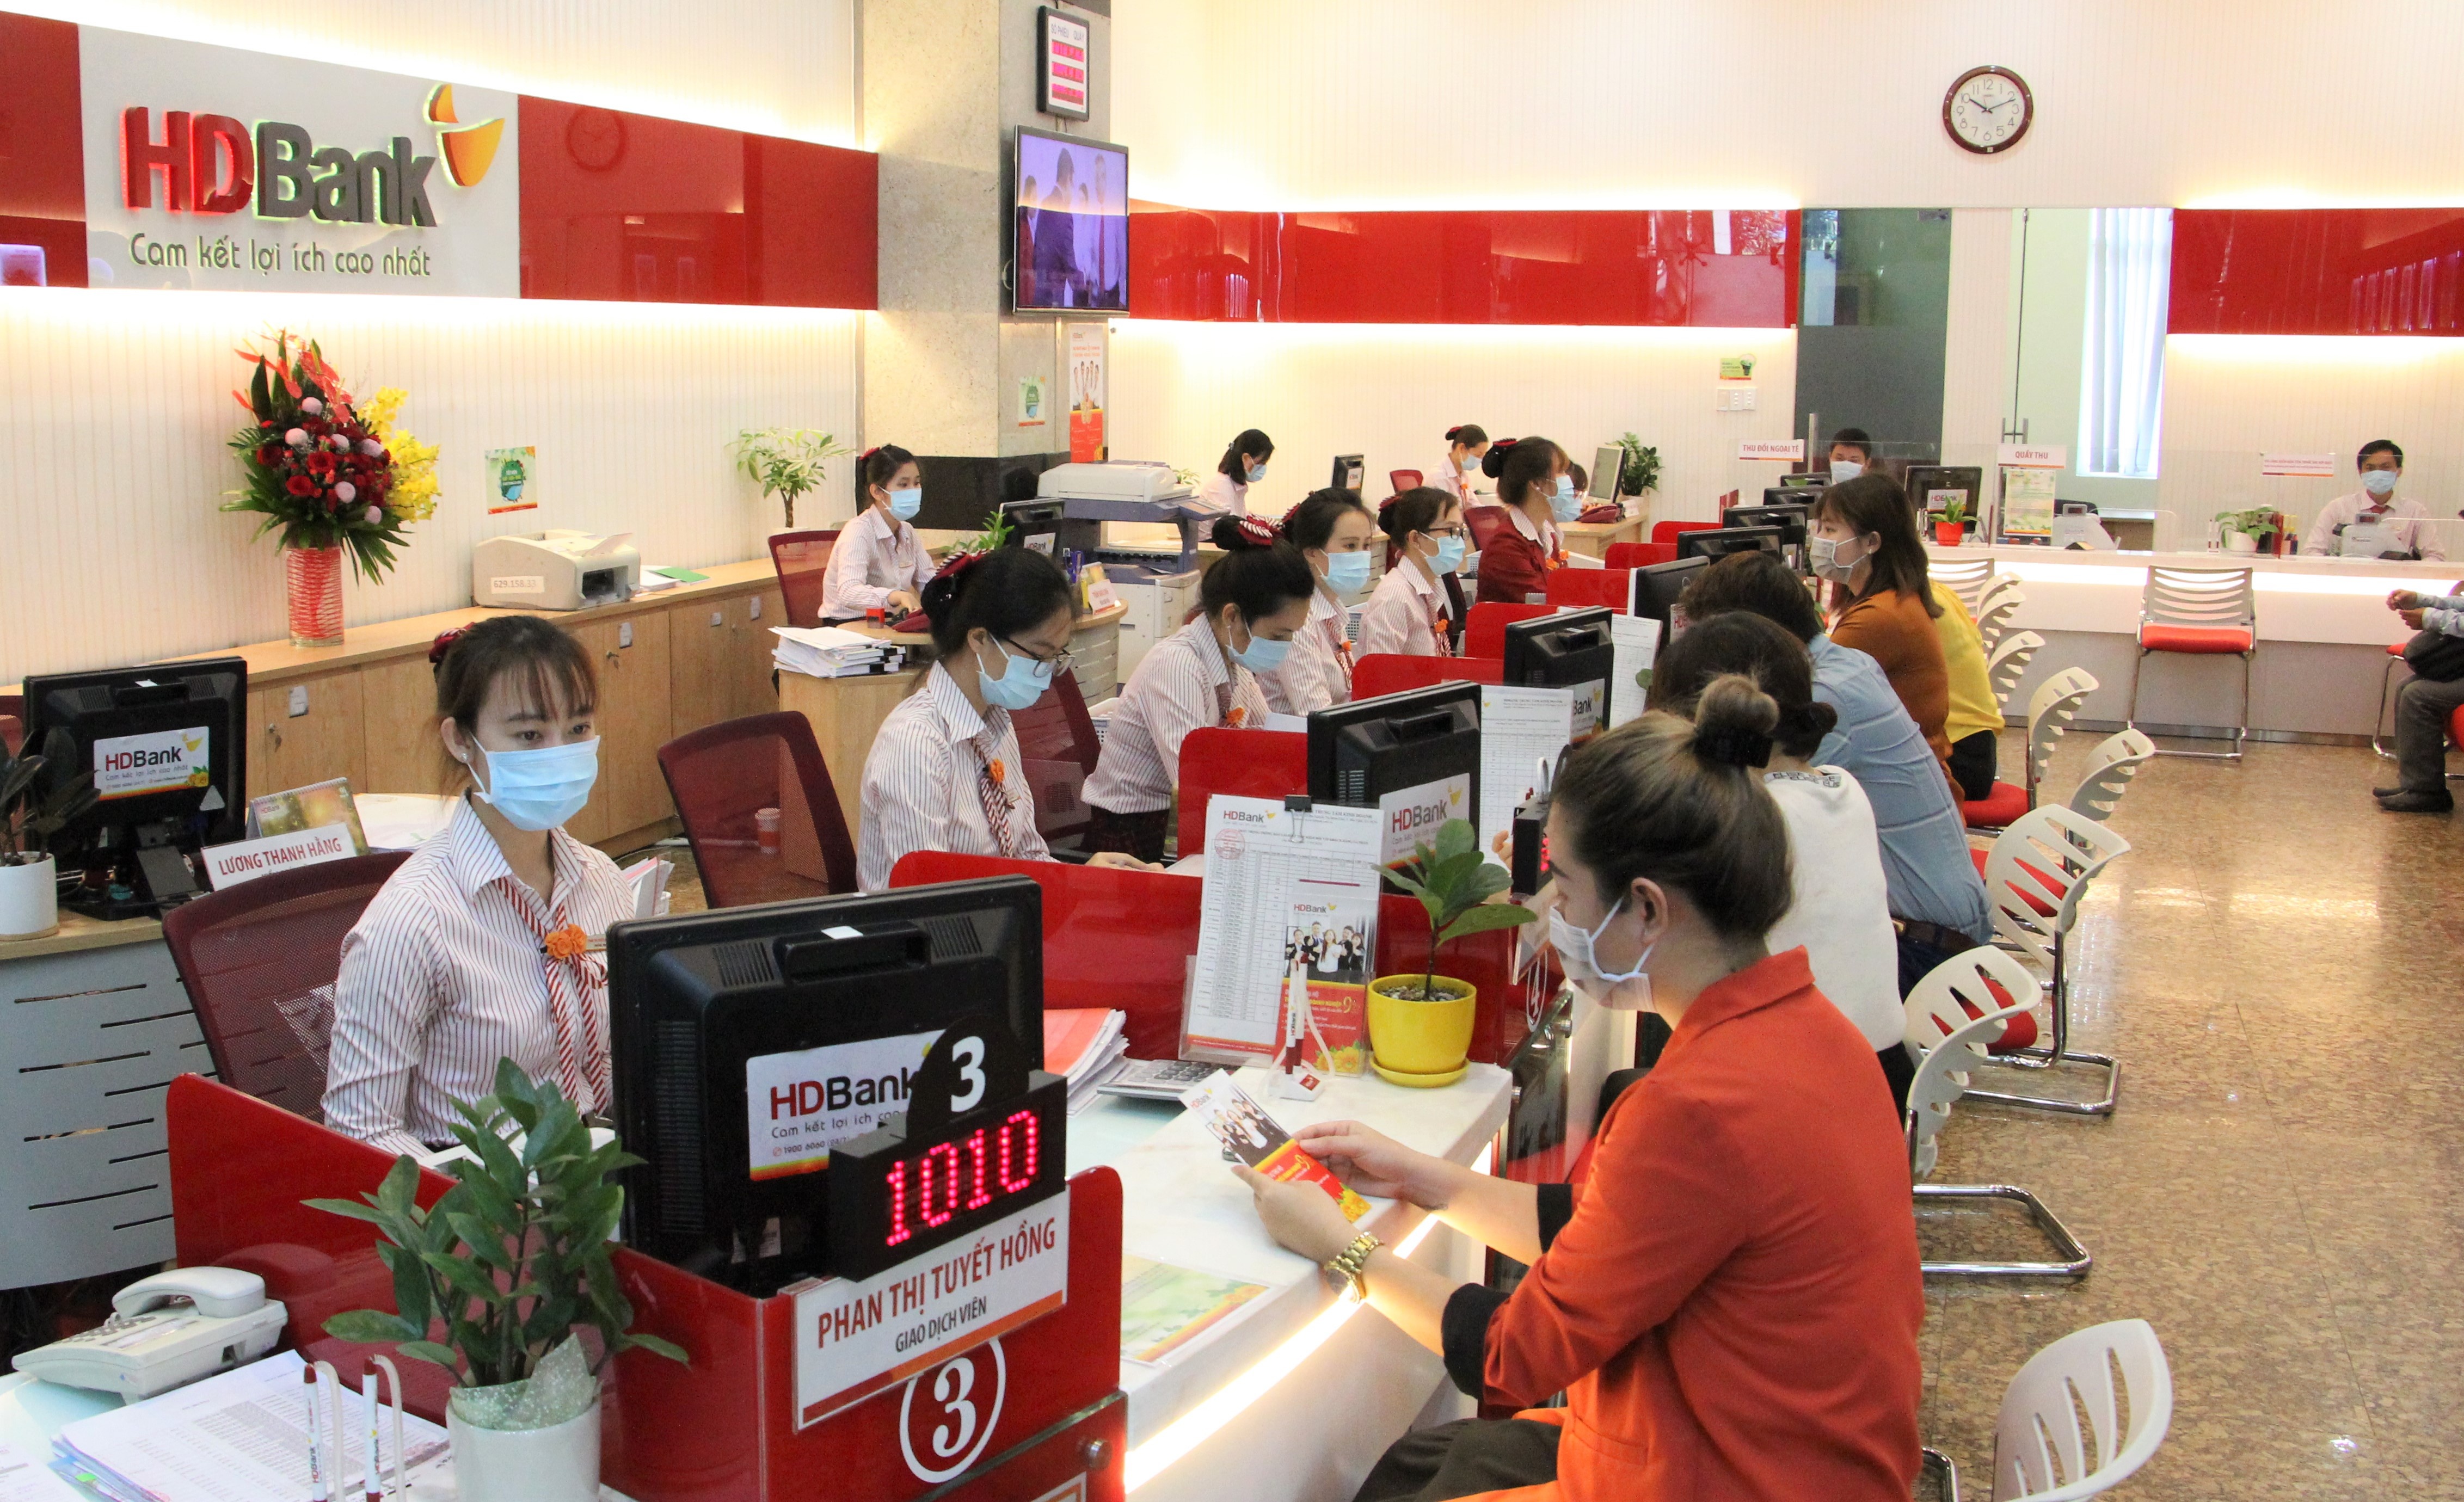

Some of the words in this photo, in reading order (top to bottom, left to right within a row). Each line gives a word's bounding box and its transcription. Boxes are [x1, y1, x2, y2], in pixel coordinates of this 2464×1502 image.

[1973, 84, 1979, 94] 11
[1983, 78, 1993, 90] 12
[1961, 93, 1970, 103] 10
[2007, 91, 2015, 102] 2
[1956, 106, 1964, 116] 9
[2012, 104, 2019, 114] 3
[1960, 119, 1967, 129] 8
[2007, 118, 2014, 126] 4
[1971, 126, 1978, 137] 7
[1983, 131, 1992, 141] 6
[1996, 126, 2004, 136] 5
[120, 106, 437, 227] HDBank
[129, 232, 187, 267] Cam
[197, 235, 241, 269] kết
[249, 237, 281, 276] lợi
[293, 242, 325, 273] ích
[334, 251, 374, 275] cao
[382, 244, 432, 277] nhất
[1771, 445, 1790, 454] NGOẠI
[106, 746, 181, 772] HDBank
[1224, 810, 1264, 823] HDBank
[1393, 799, 1447, 833] HDBank
[218, 852, 262, 876] LƯƠNG
[262, 845, 306, 866] THANH
[307, 836, 342, 858] HẰNG
[1294, 903, 1327, 913] HDBank
[950, 1036, 986, 1112] 3
[771, 1067, 919, 1120] HDBank
[772, 1126, 798, 1138] Cam
[805, 1120, 826, 1132] kết
[832, 1118, 848, 1129] lợi
[853, 1112, 872, 1125] ích
[784, 1144, 802, 1154] 1900
[886, 1110, 1038, 1247] 1010
[818, 1289, 882, 1349] PHAN
[889, 1273, 925, 1315] THỊ
[931, 1236, 996, 1300] TUYẾT
[1000, 1217, 1055, 1270] HỒNG
[895, 1327, 925, 1352] GIAO
[929, 1309, 957, 1340] DỊCH
[960, 1296, 987, 1325] VIÊN
[932, 1357, 976, 1457] 3
